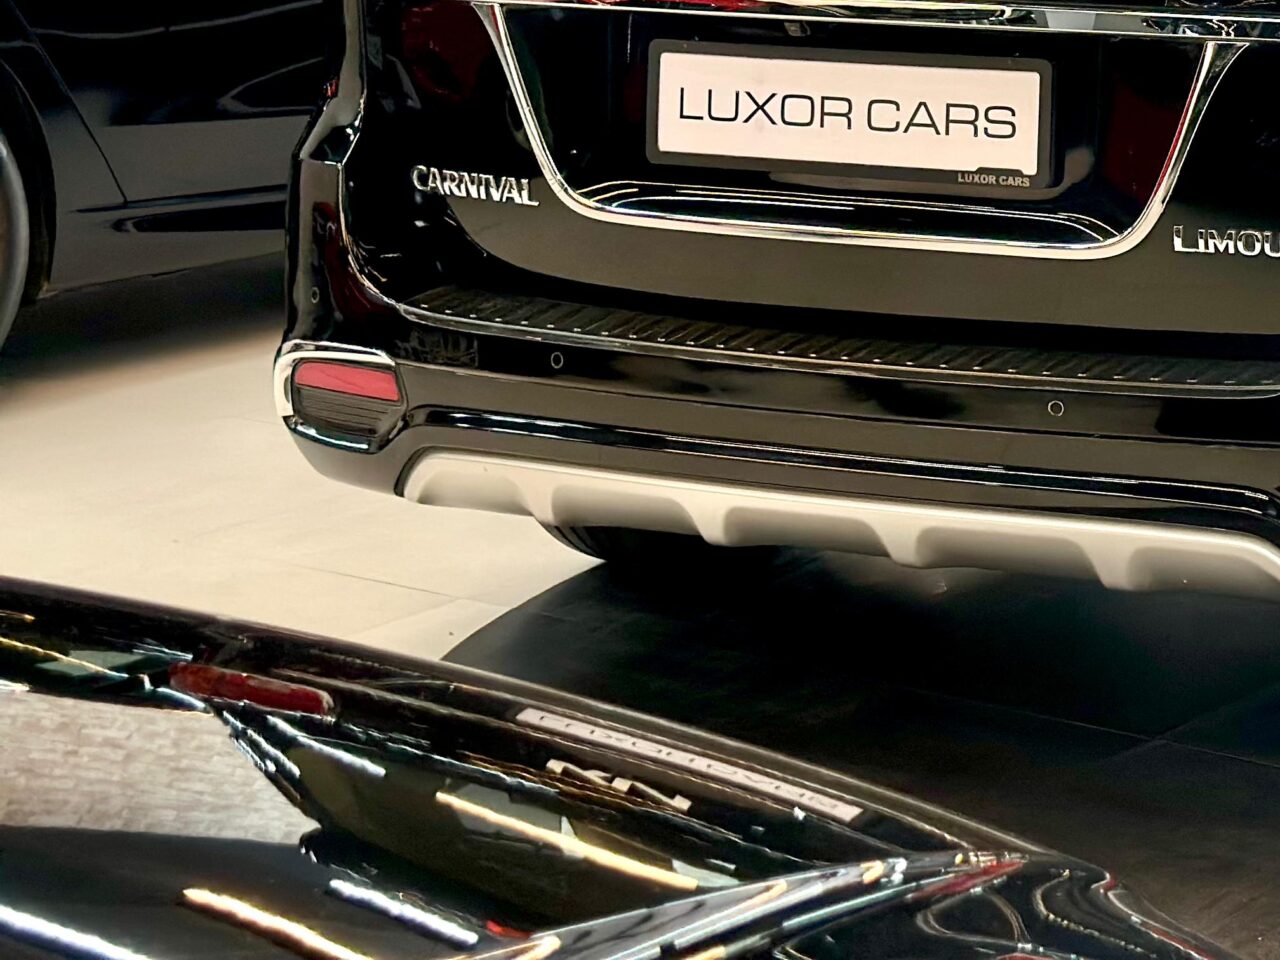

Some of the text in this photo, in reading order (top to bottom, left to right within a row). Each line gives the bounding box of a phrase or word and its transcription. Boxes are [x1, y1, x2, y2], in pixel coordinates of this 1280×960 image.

[679, 86, 1018, 139] LUXOR CARS
[411, 164, 540, 206] CARNIVAL
[957, 172, 1030, 187] LUXOR CARS
